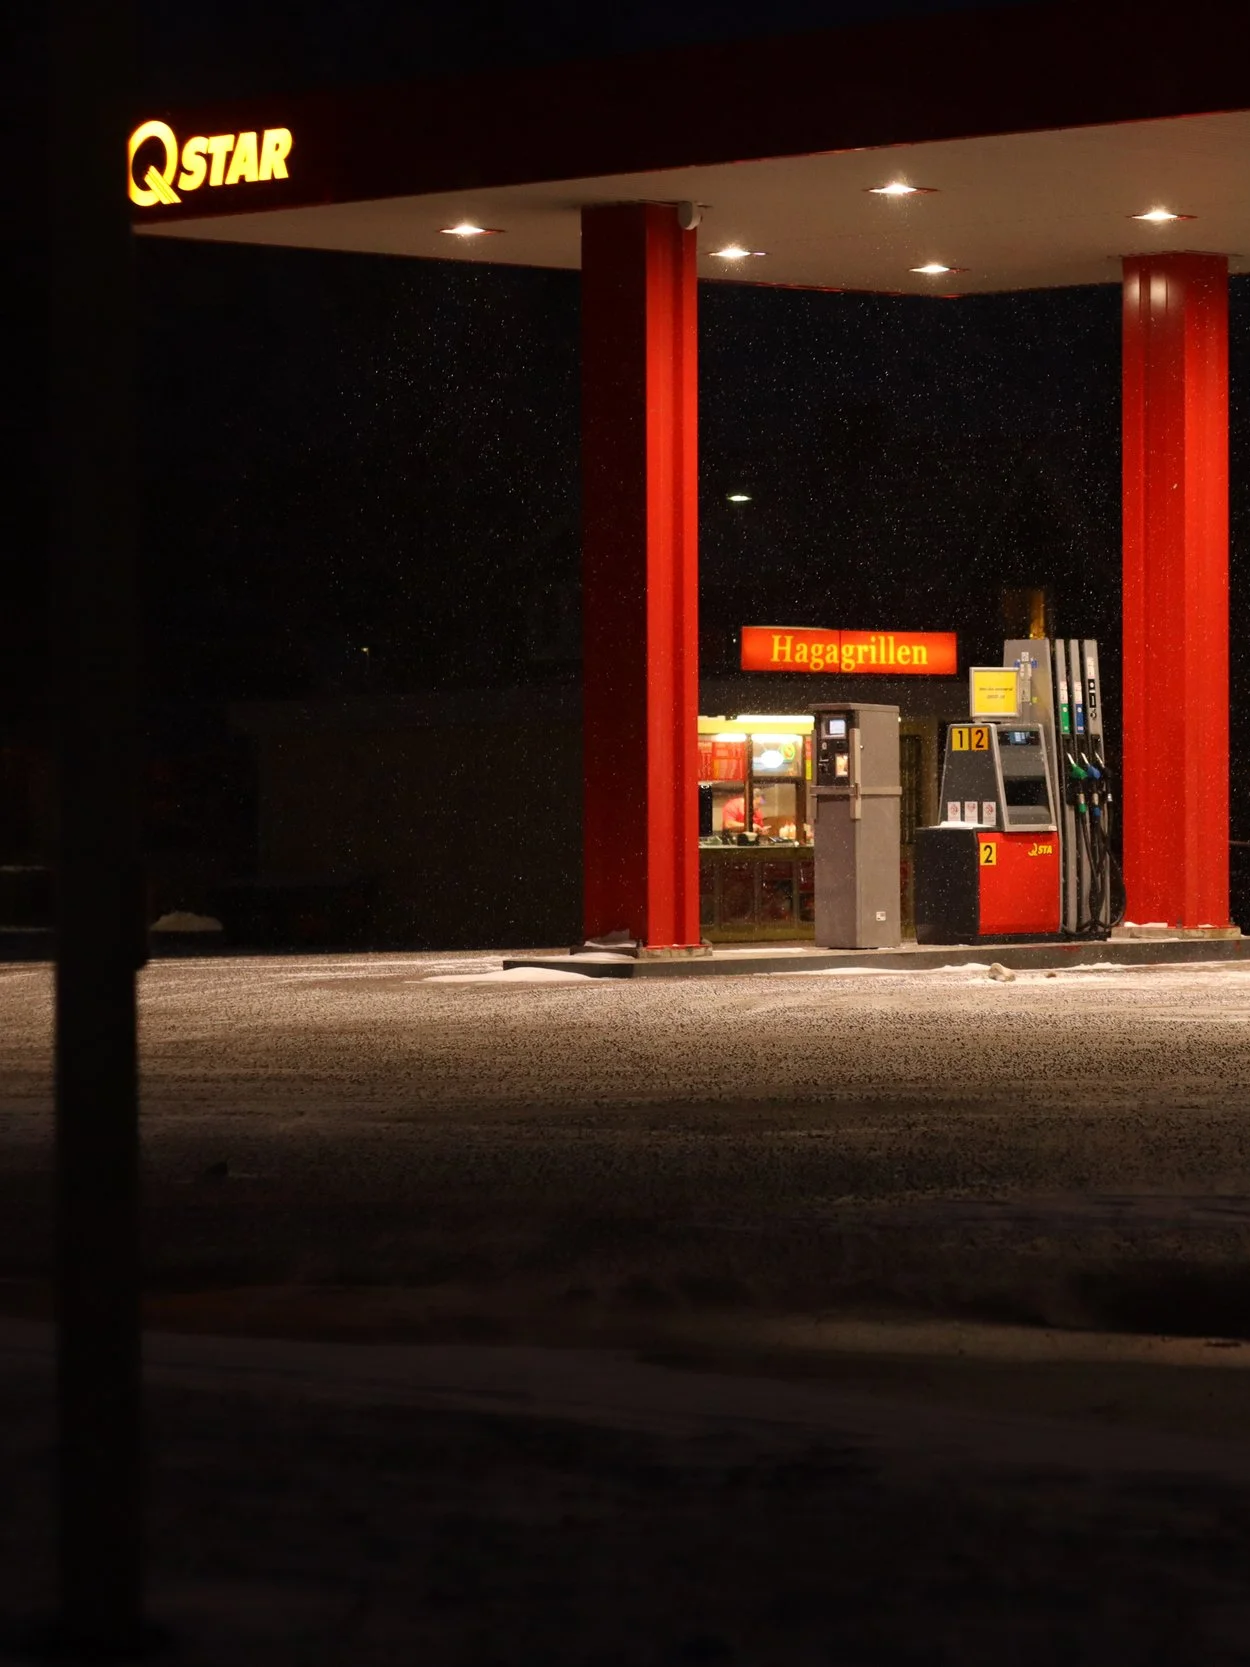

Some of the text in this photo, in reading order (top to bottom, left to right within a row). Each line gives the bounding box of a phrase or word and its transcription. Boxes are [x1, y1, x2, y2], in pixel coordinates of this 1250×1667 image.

[128, 120, 292, 206] QSTAR
[770, 634, 929, 671] Hagagrillen
[957, 729, 985, 749] 1 2
[983, 845, 993, 863] 2
